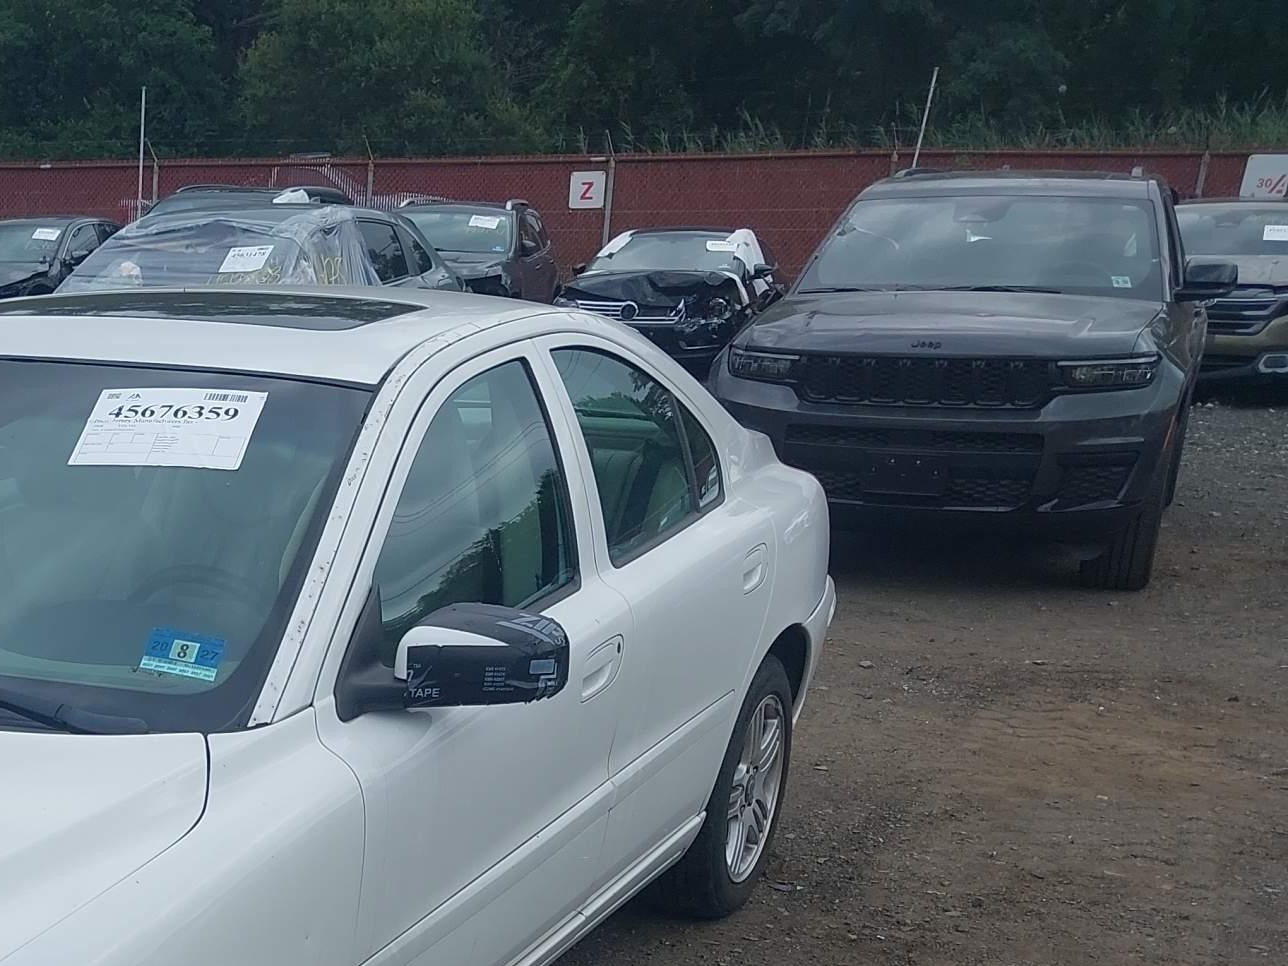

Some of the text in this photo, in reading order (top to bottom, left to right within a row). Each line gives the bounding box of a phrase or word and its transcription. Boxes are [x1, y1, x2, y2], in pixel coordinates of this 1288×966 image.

[579, 181, 595, 201] Z
[911, 340, 943, 351] Jeep
[107, 404, 241, 422] 45676359
[151, 640, 219, 661] 20 8 27
[408, 688, 441, 698] TAPE
